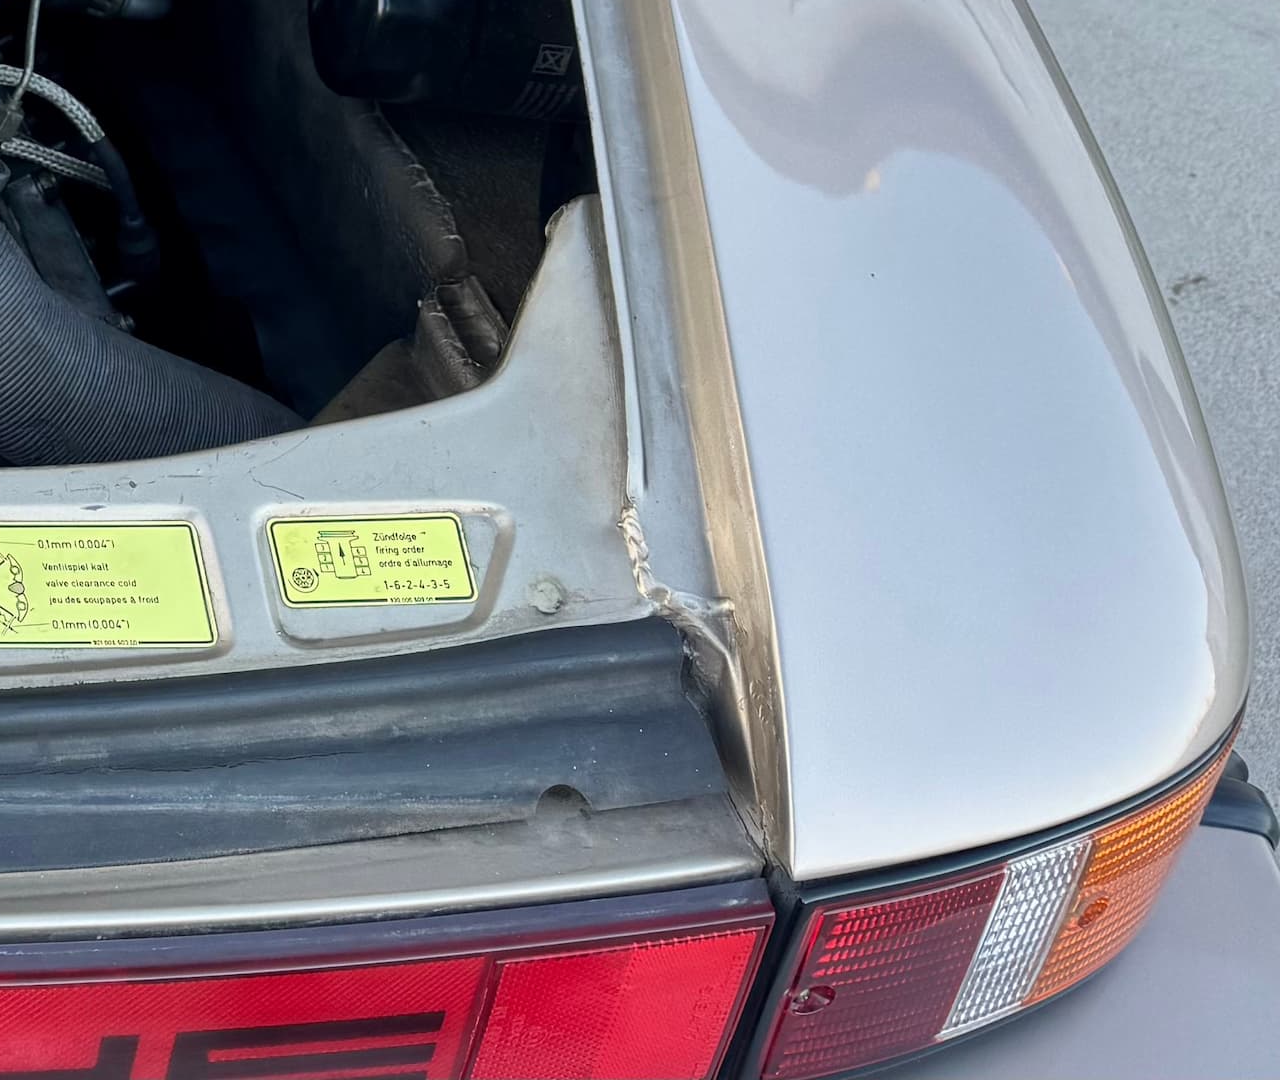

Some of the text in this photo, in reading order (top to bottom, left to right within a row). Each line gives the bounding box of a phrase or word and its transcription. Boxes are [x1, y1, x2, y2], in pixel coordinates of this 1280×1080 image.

[372, 532, 417, 543] Zündfolge
[375, 546, 425, 556] firing order
[42, 562, 109, 573] Ventilspiel kalt
[378, 560, 402, 568] ordre
[45, 579, 137, 588] valve clearance cold
[383, 579, 451, 590] 1-6-2-4-3-5
[49, 596, 63, 605] jeu
[65, 596, 81, 604] des
[83, 596, 128, 605] soupapes
[138, 596, 160, 604] froid
